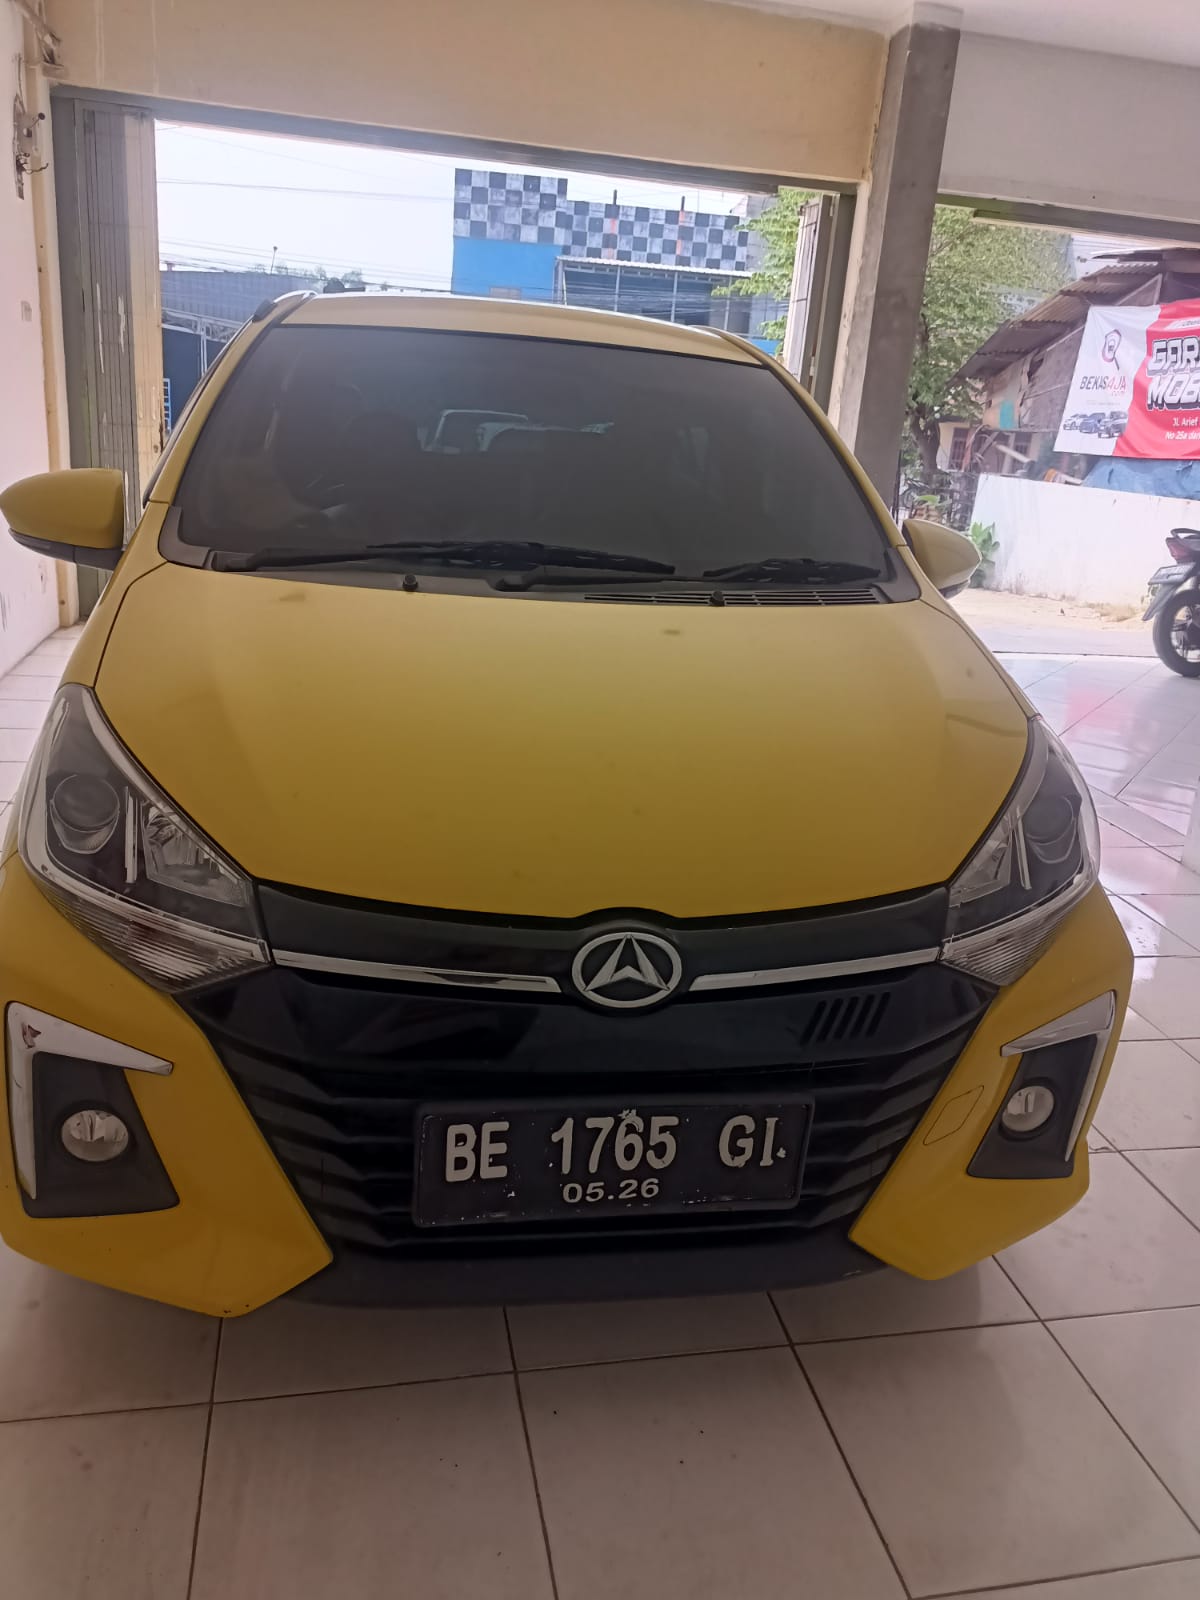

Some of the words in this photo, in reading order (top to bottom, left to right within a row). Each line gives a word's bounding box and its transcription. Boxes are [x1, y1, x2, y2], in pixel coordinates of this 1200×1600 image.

[1147, 337, 1200, 373] GAR
[1147, 373, 1200, 410] MOB
[445, 1121, 510, 1182] BE
[551, 1114, 679, 1174] 1765
[719, 1115, 779, 1168] GI
[562, 1178, 660, 1203] 05.26
